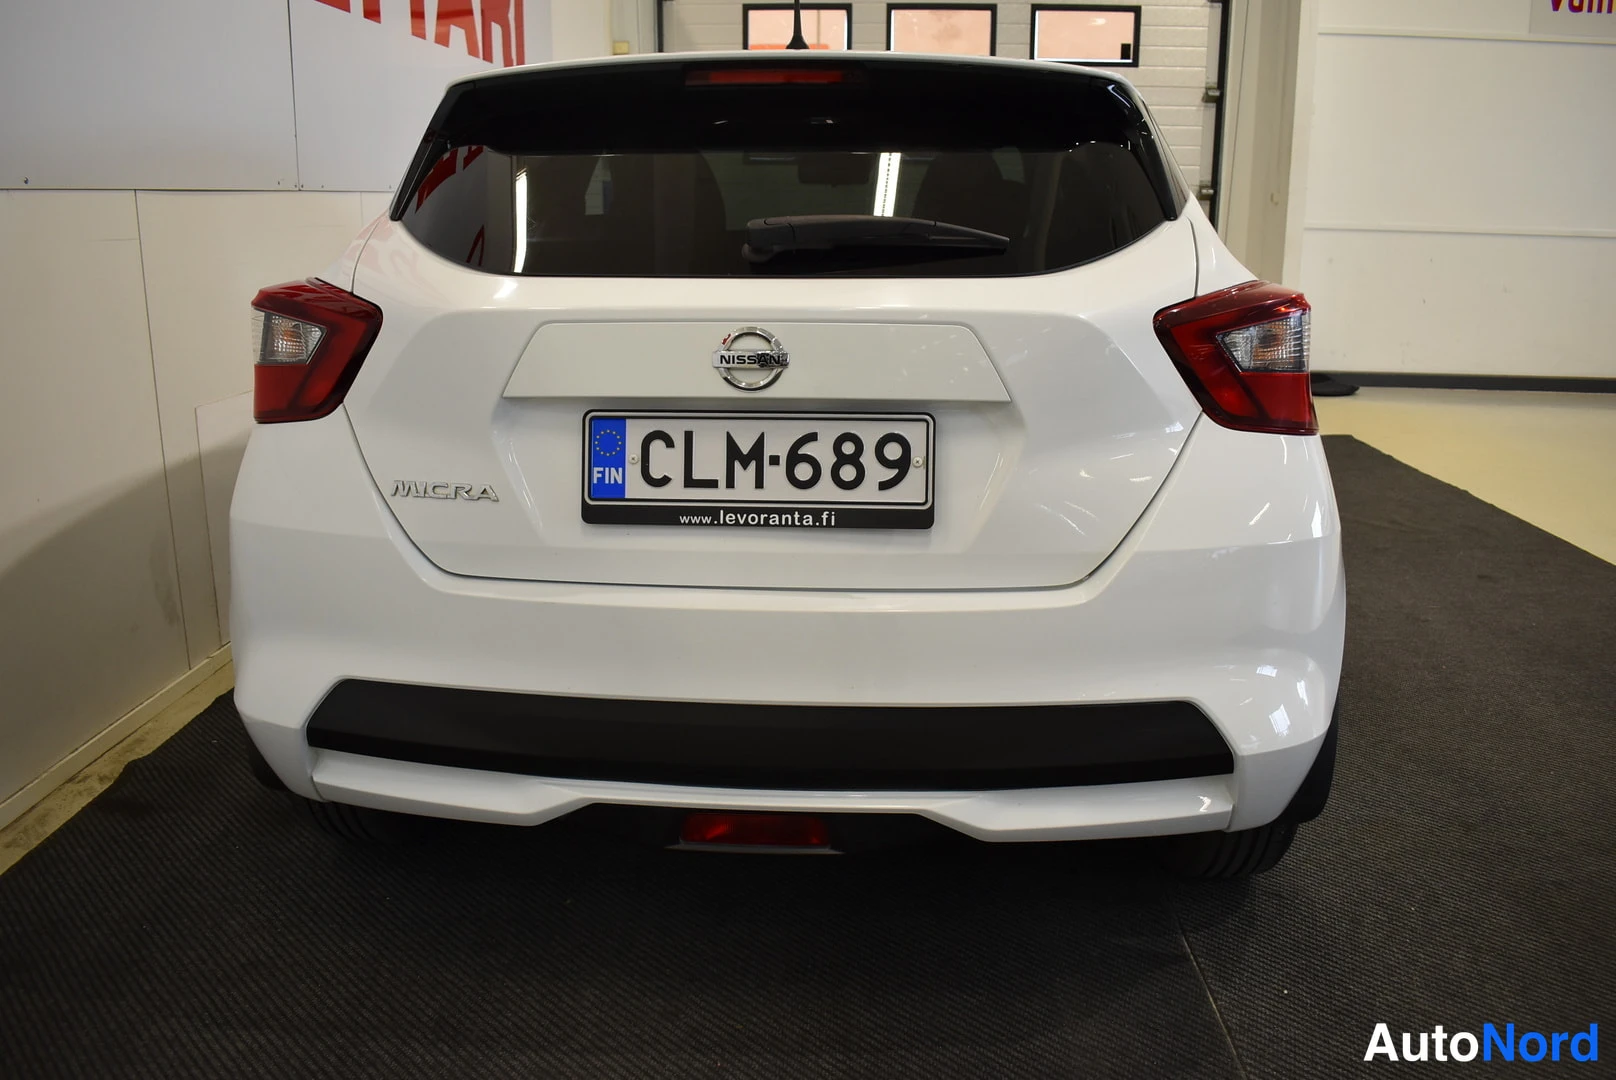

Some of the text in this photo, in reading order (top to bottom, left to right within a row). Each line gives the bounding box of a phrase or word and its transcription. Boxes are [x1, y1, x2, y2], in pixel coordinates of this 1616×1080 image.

[719, 354, 781, 365] NISSAN
[593, 429, 912, 491] FIN CLM-689
[390, 479, 500, 502] MICRA
[679, 508, 836, 526] www.levoranta.fi
